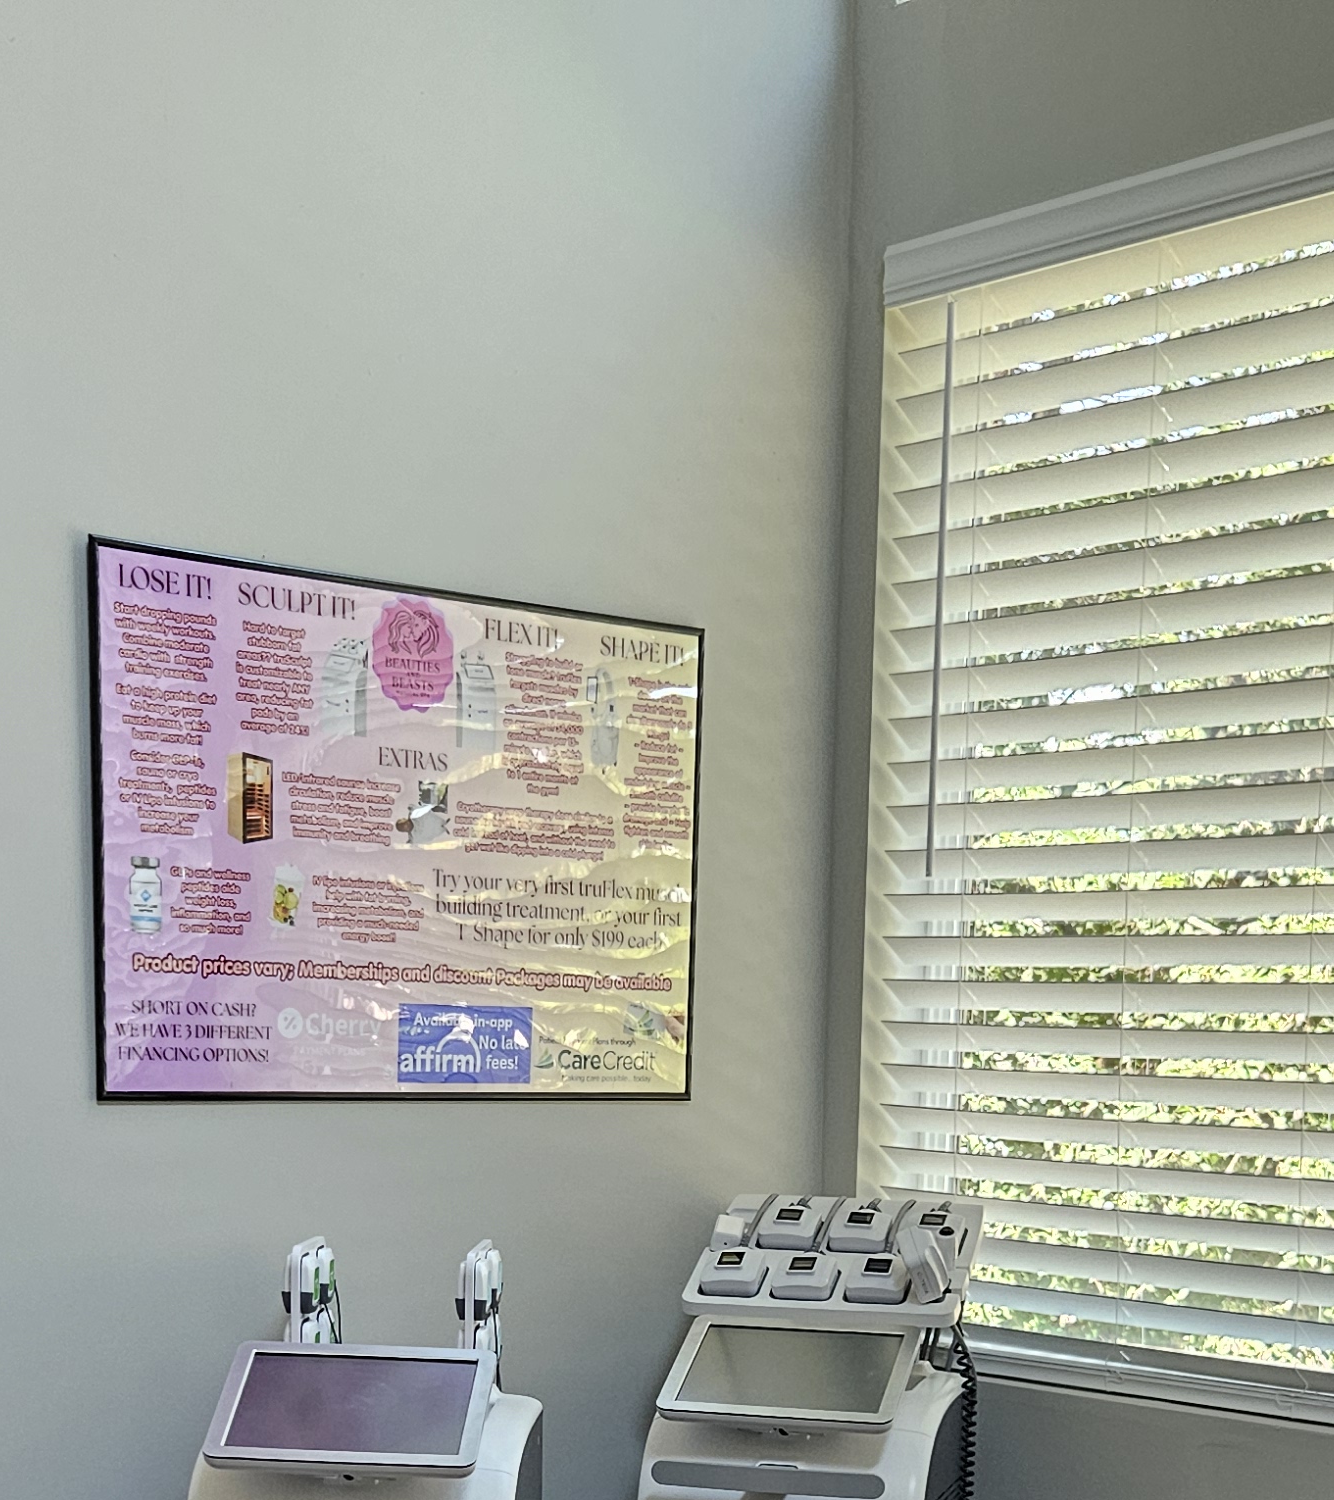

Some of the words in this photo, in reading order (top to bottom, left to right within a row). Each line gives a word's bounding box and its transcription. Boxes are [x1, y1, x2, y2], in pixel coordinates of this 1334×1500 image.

[118, 563, 179, 595] LOSE
[186, 574, 212, 600] IT!
[237, 582, 326, 616] SCULPT
[330, 596, 356, 621] IT!
[485, 618, 535, 646] FLEX
[537, 627, 558, 650] IT!
[600, 635, 660, 664] SHAPE
[665, 644, 684, 666] IT!
[384, 656, 441, 673] BEAUTIES
[392, 678, 434, 691] BEASTS
[378, 746, 449, 772] EXTRAS
[132, 952, 199, 974] Product
[202, 954, 250, 978] prices
[254, 962, 294, 980] vary;
[298, 960, 400, 984] Memberships
[402, 964, 430, 982] and
[433, 965, 492, 984] discount
[495, 968, 561, 991] Packages
[562, 974, 593, 992] may
[595, 971, 612, 989] be
[614, 973, 672, 991] available
[132, 1000, 182, 1015] SHORT
[187, 1001, 208, 1016] ON
[212, 1002, 256, 1017] CASH?
[115, 1023, 140, 1037] WE
[143, 1023, 182, 1038] HAVE
[185, 1024, 192, 1041] 3
[195, 1024, 272, 1039] DIFFERENT
[474, 1014, 513, 1031] in-app
[479, 1035, 497, 1049] No
[118, 1046, 199, 1061] FINANCING
[203, 1047, 269, 1062] OPTIONS!
[400, 1046, 474, 1072] affirm
[486, 1056, 518, 1070] fees!
[558, 1050, 655, 1071] CareCredit
